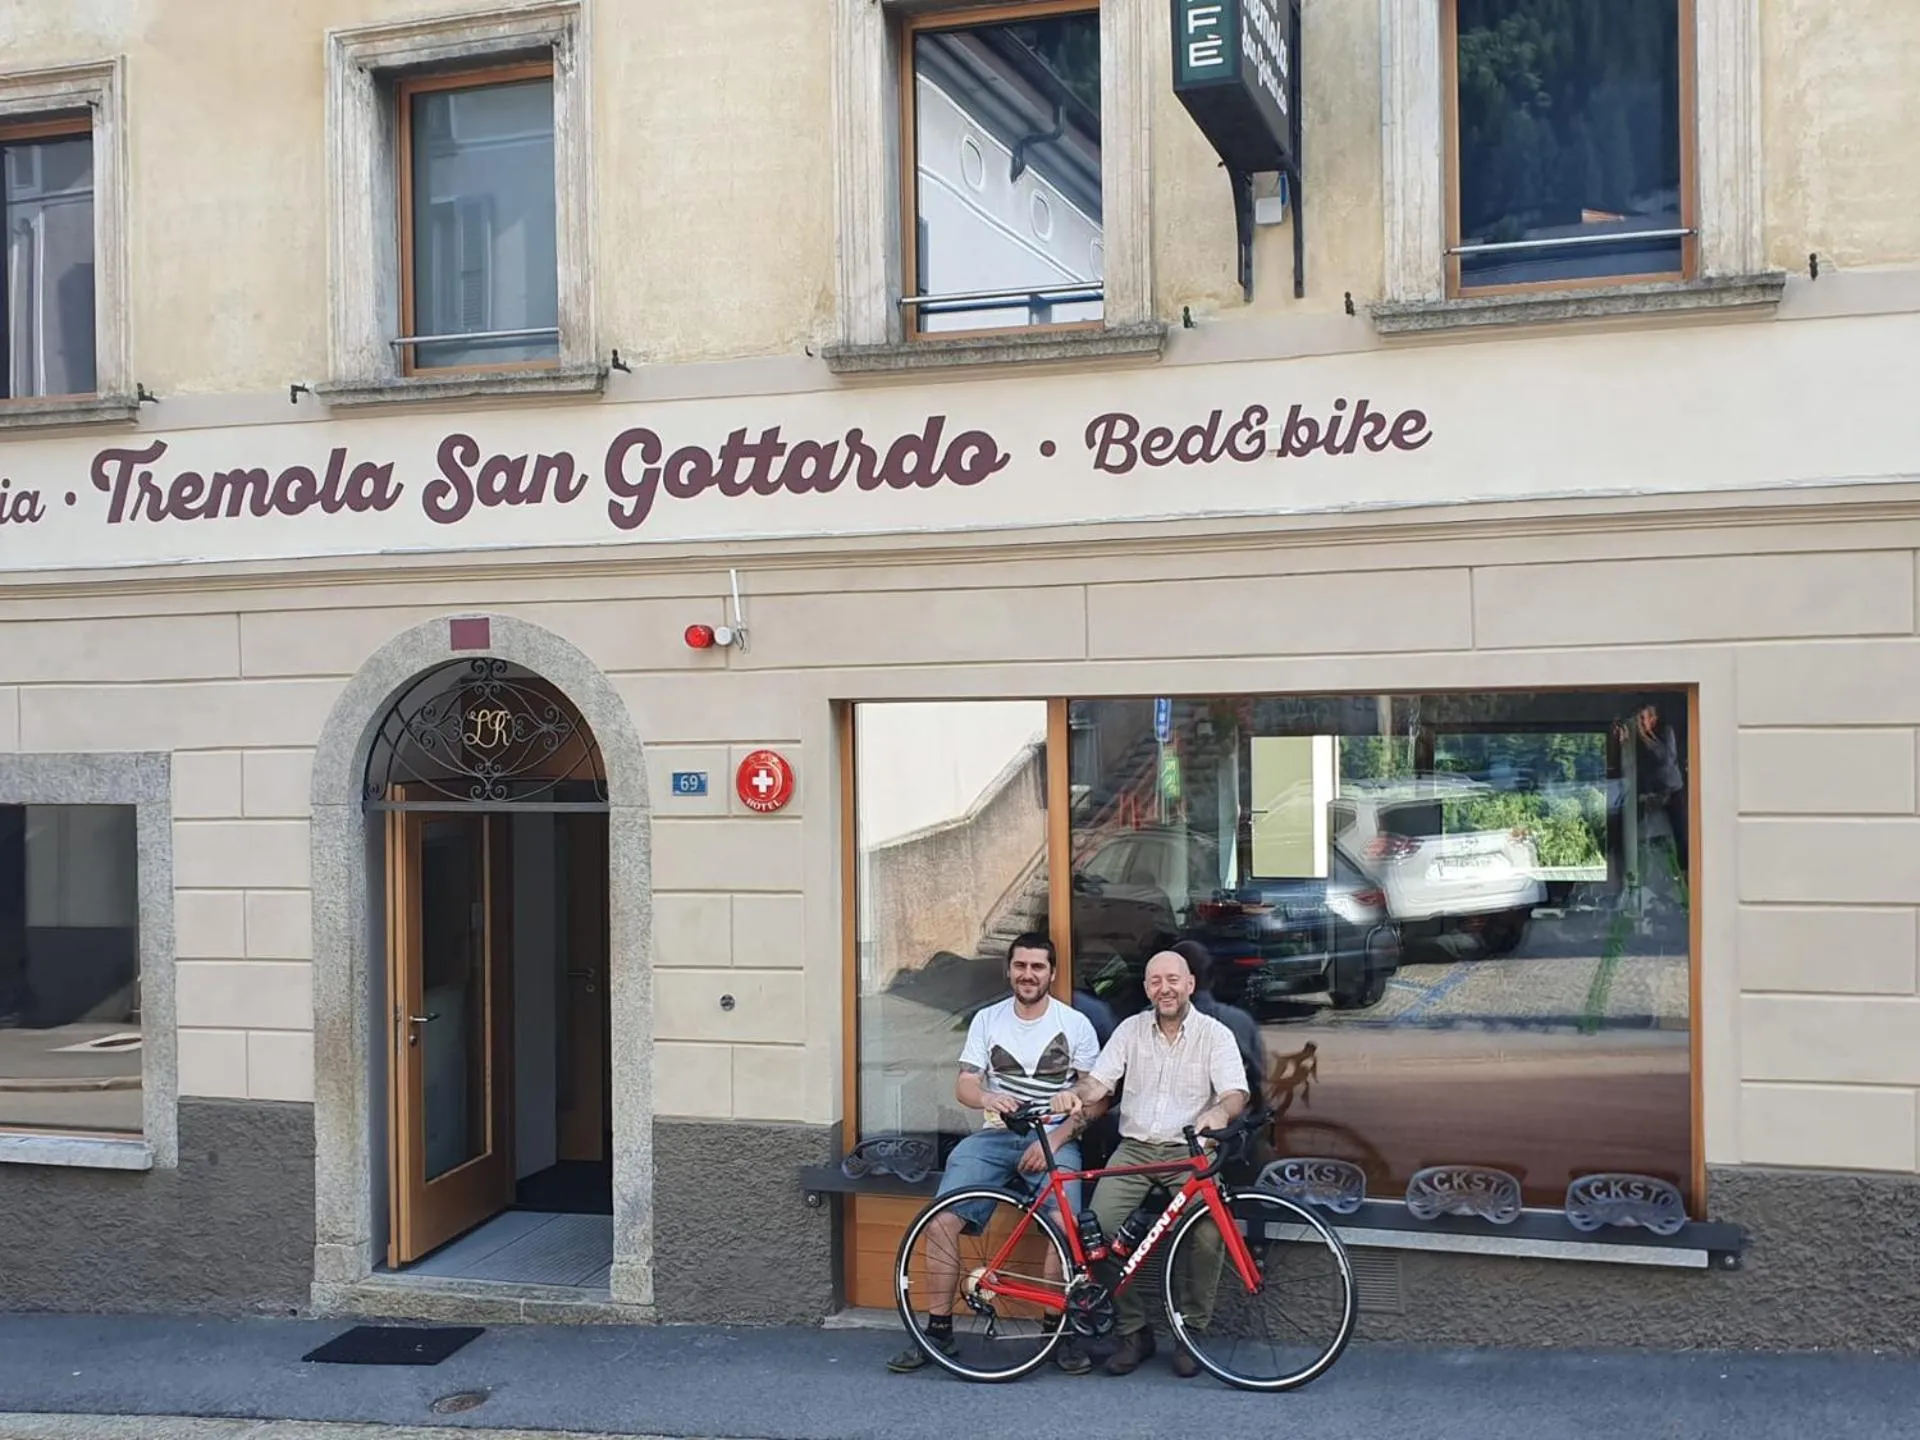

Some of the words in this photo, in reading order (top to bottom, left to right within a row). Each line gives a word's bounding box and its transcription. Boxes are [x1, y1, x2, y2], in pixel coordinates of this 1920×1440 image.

[1187, 0, 1223, 67] FÈ
[91, 440, 404, 523] Tremola
[422, 433, 588, 524] San
[604, 415, 1010, 529] Gottardo
[681, 775, 698, 791] 69
[746, 798, 782, 811] HOTEL
